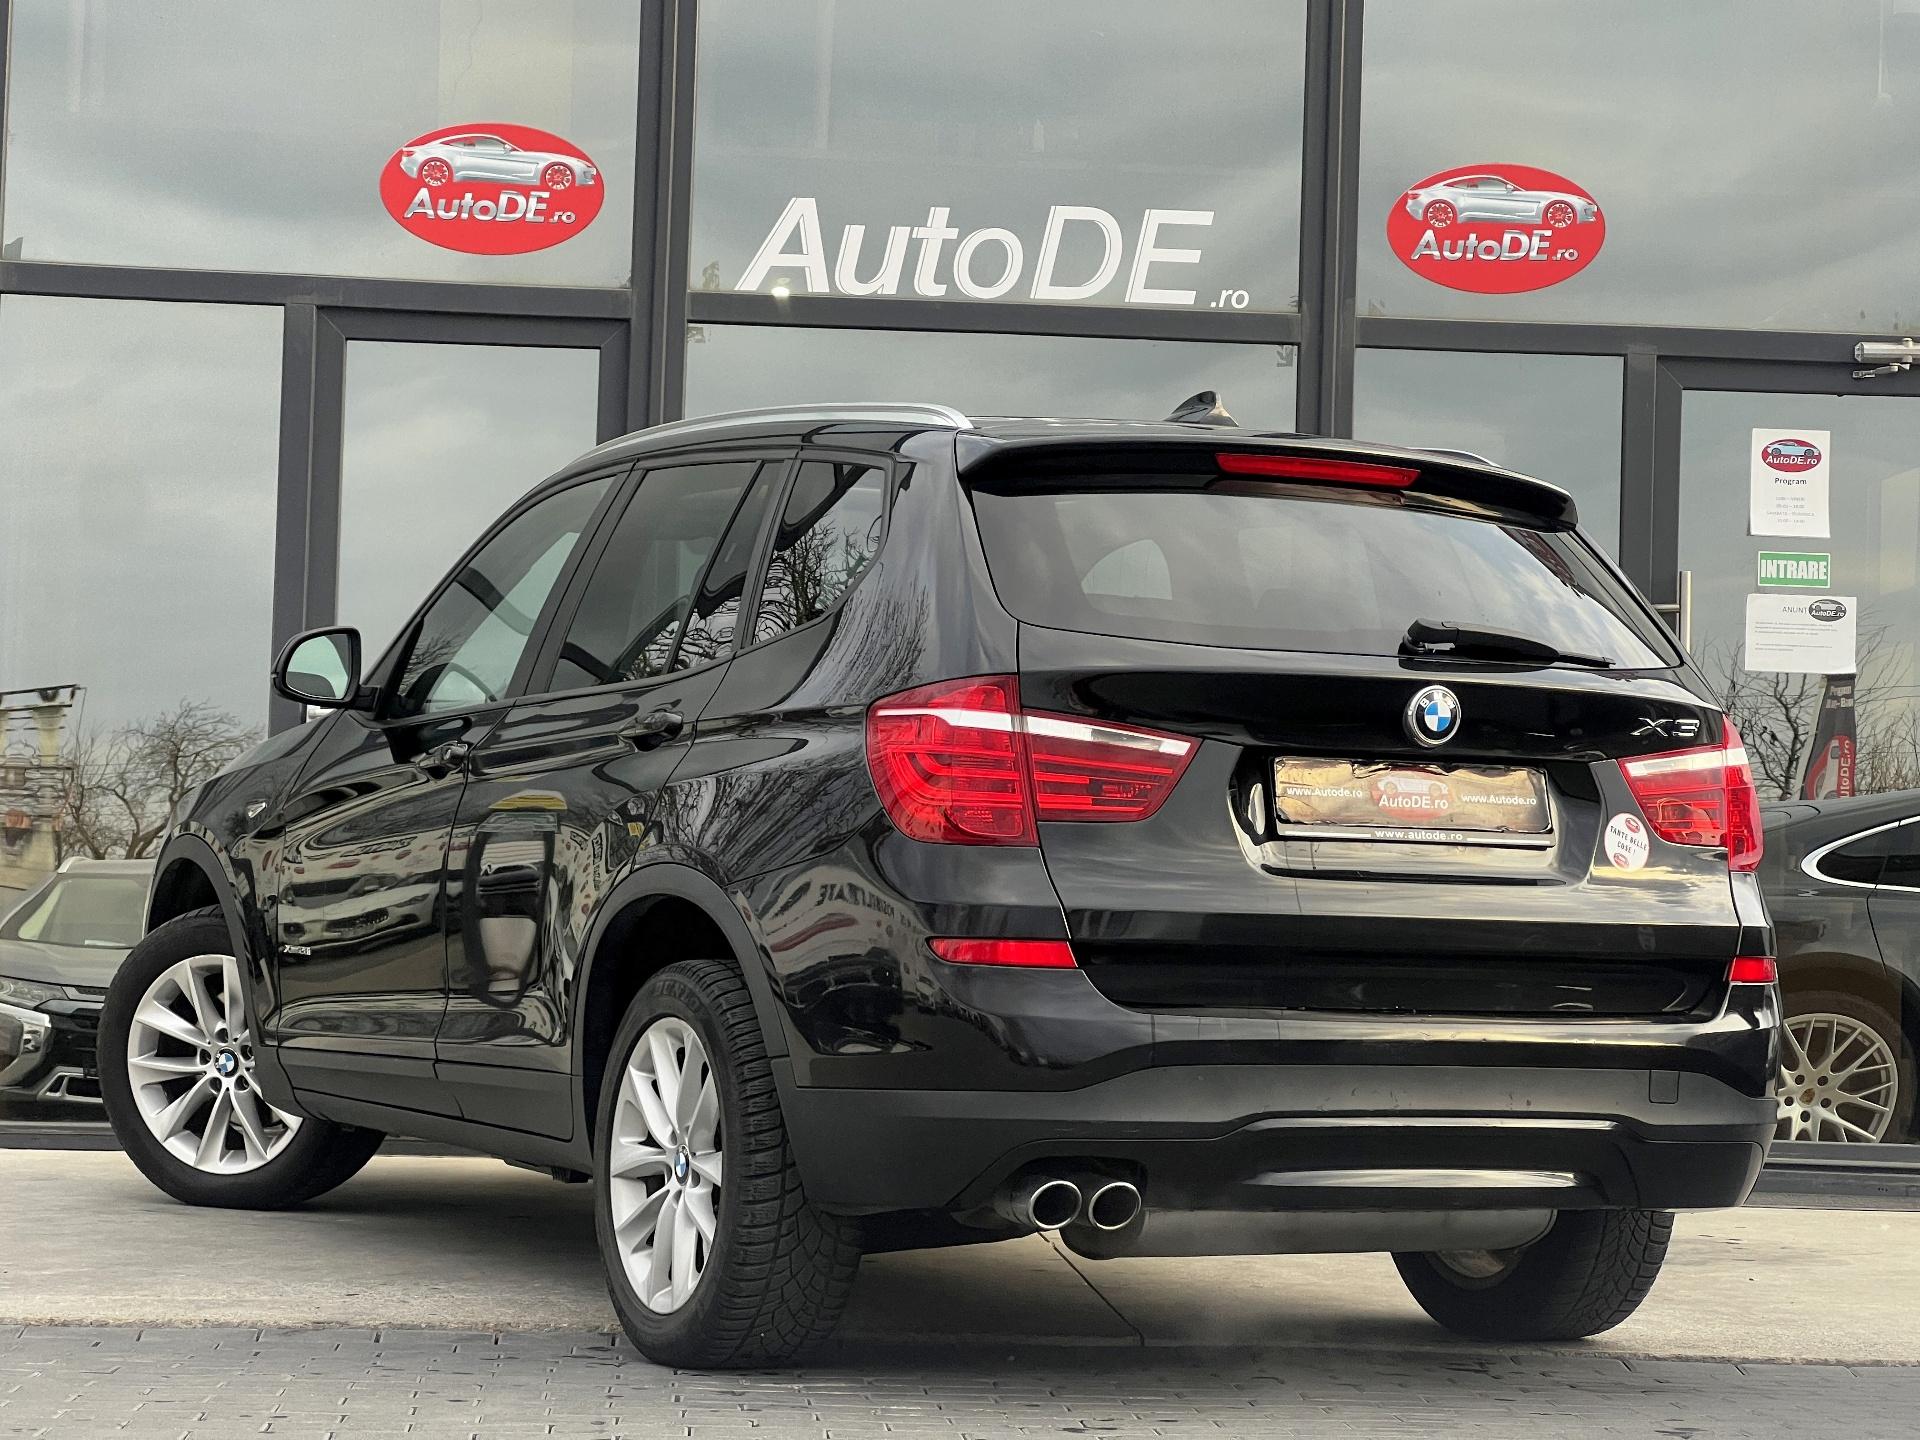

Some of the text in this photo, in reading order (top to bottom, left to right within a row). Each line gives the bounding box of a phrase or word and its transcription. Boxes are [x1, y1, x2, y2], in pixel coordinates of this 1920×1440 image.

[1774, 477, 1808, 486] Program
[1760, 559, 1828, 580] INTRARE
[1630, 717, 1700, 737] X3
[1840, 740, 1851, 797] utoDE.ro
[1286, 786, 1363, 799] www.Autode.ro
[1461, 793, 1537, 806] www.Autode.ro
[1378, 794, 1449, 810] AutoDE.ro
[1374, 829, 1464, 842] www.autode.ro
[1610, 826, 1628, 840] TANTE
